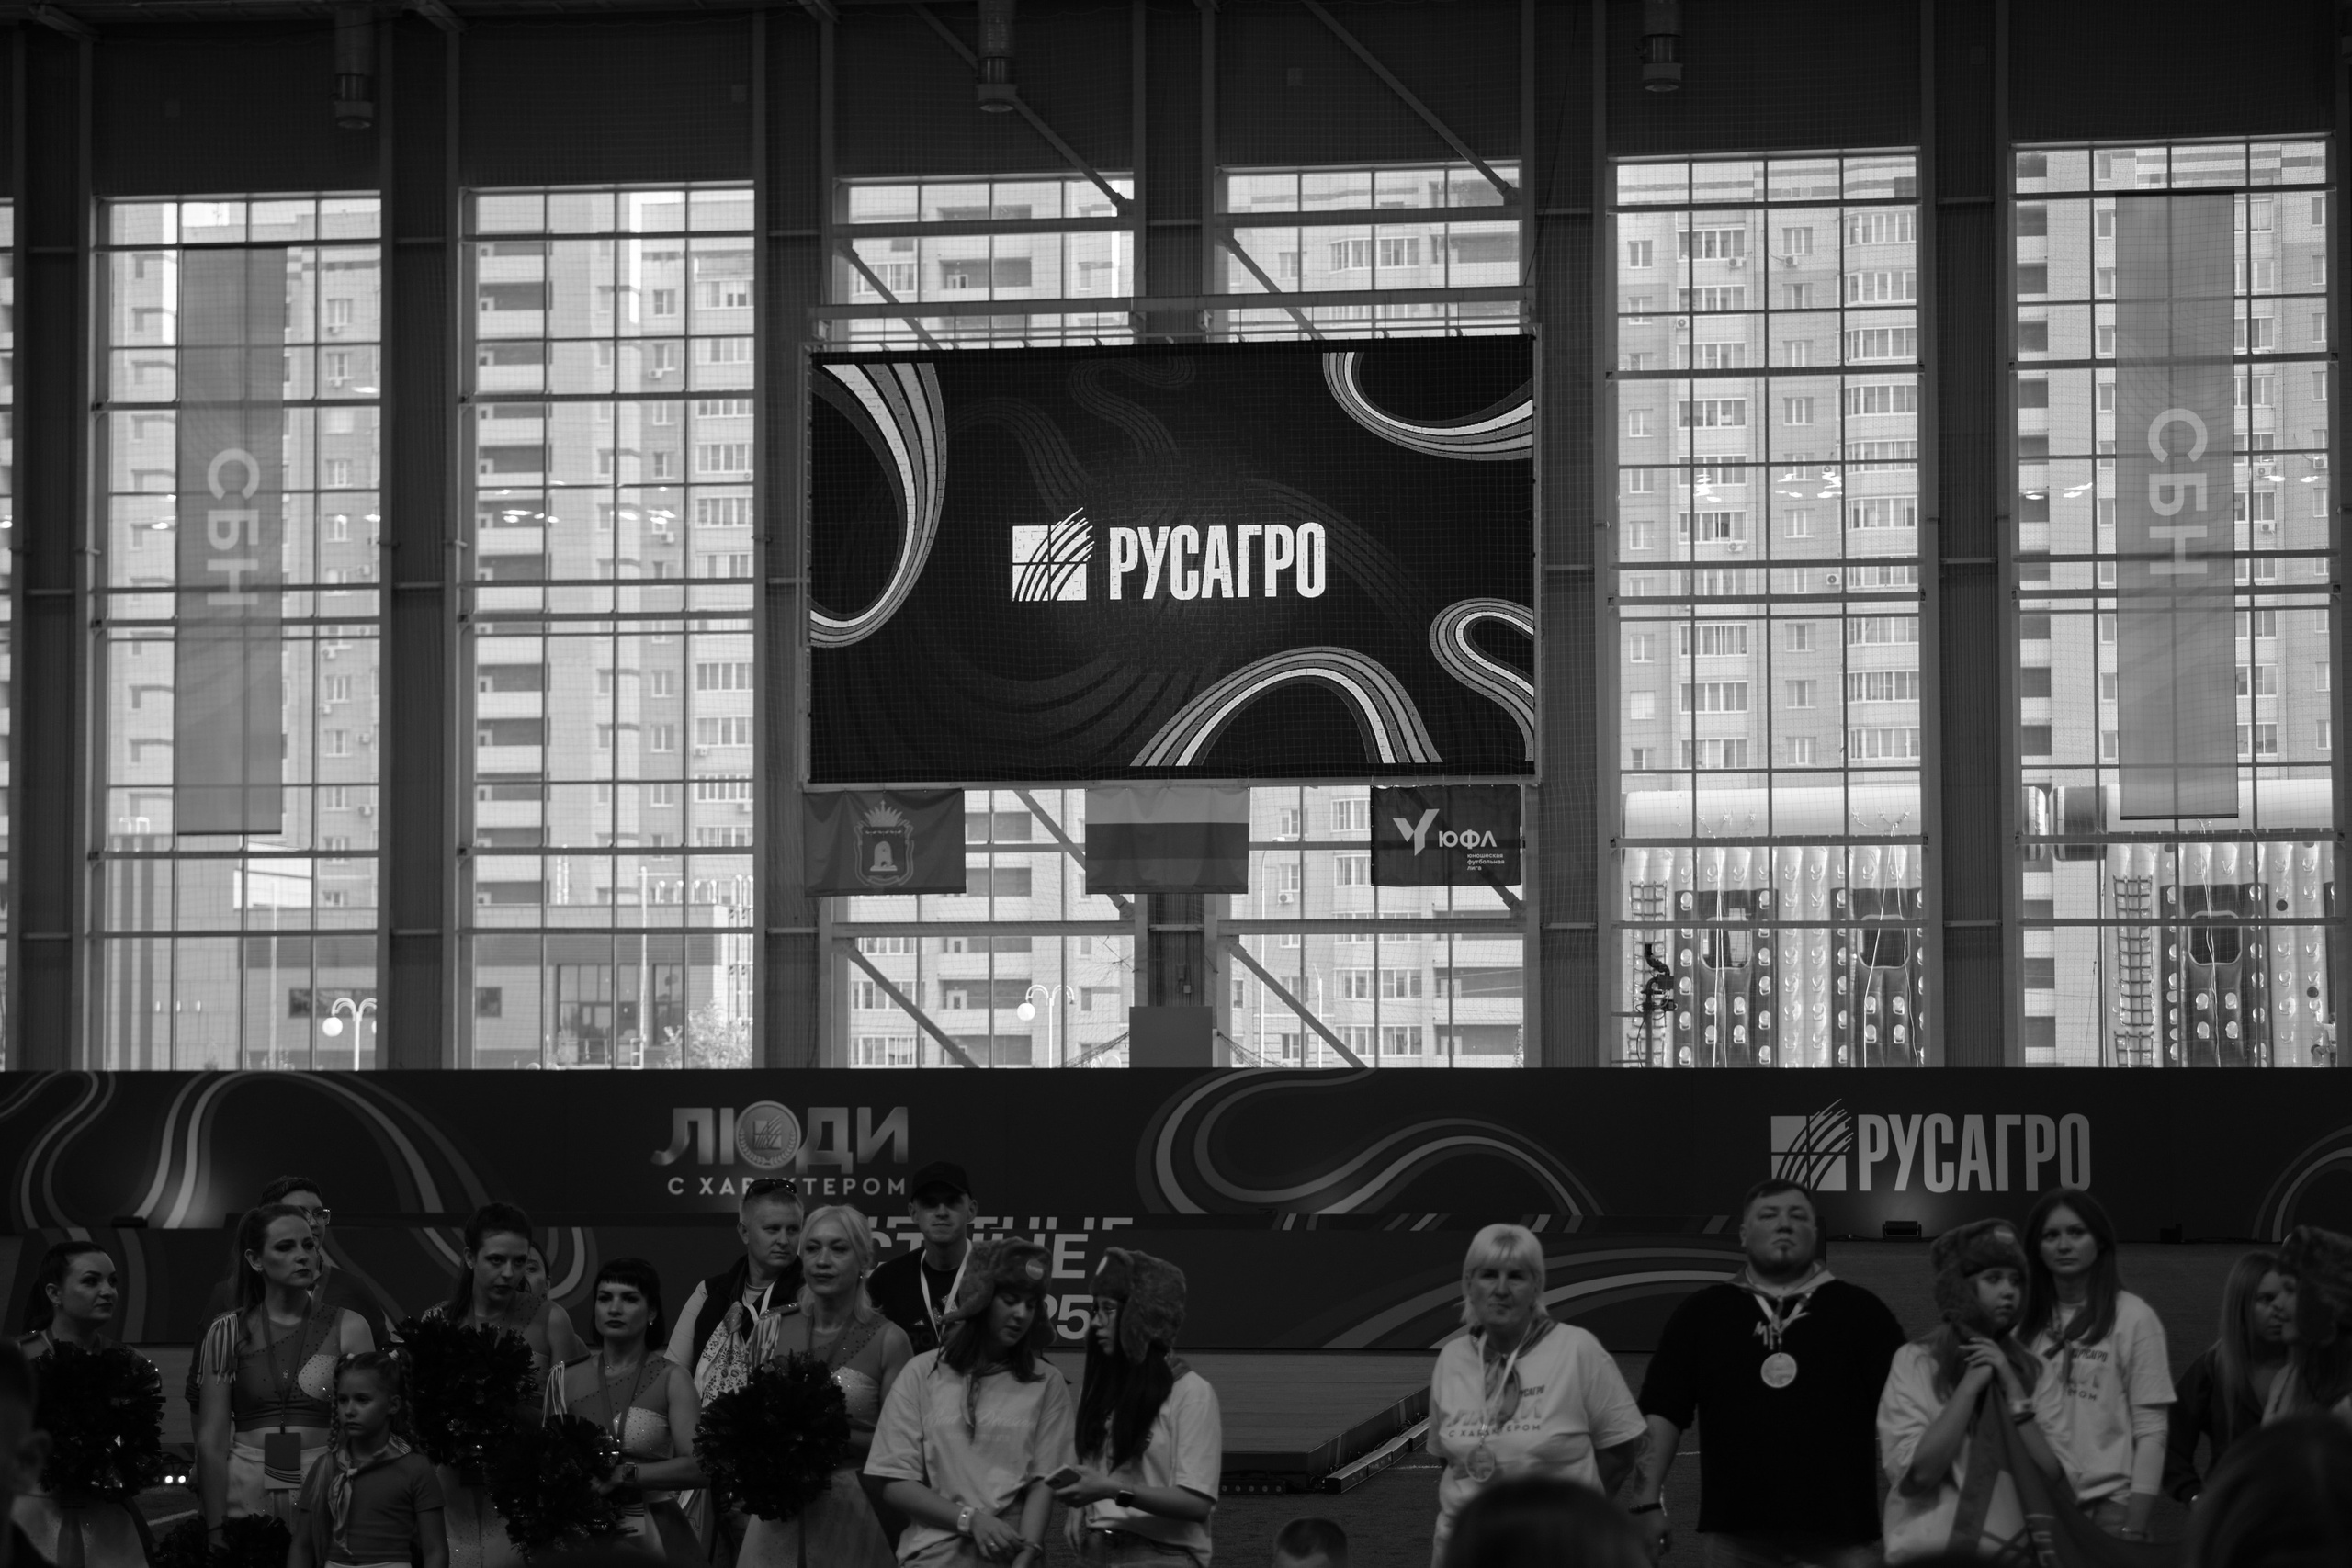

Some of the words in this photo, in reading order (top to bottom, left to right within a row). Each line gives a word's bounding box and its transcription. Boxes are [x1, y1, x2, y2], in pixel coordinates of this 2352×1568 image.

[207, 447, 261, 605] СБН
[2147, 408, 2209, 575] СБН
[1109, 523, 1327, 601] РУСАГРО
[1438, 829, 1498, 850] ЮФЛ
[650, 1100, 910, 1175] ЛЮДИ
[1858, 1113, 2092, 1194] РУСАГРО
[667, 1177, 684, 1196] С
[698, 1176, 906, 1196] ХАРТЕРОМ
